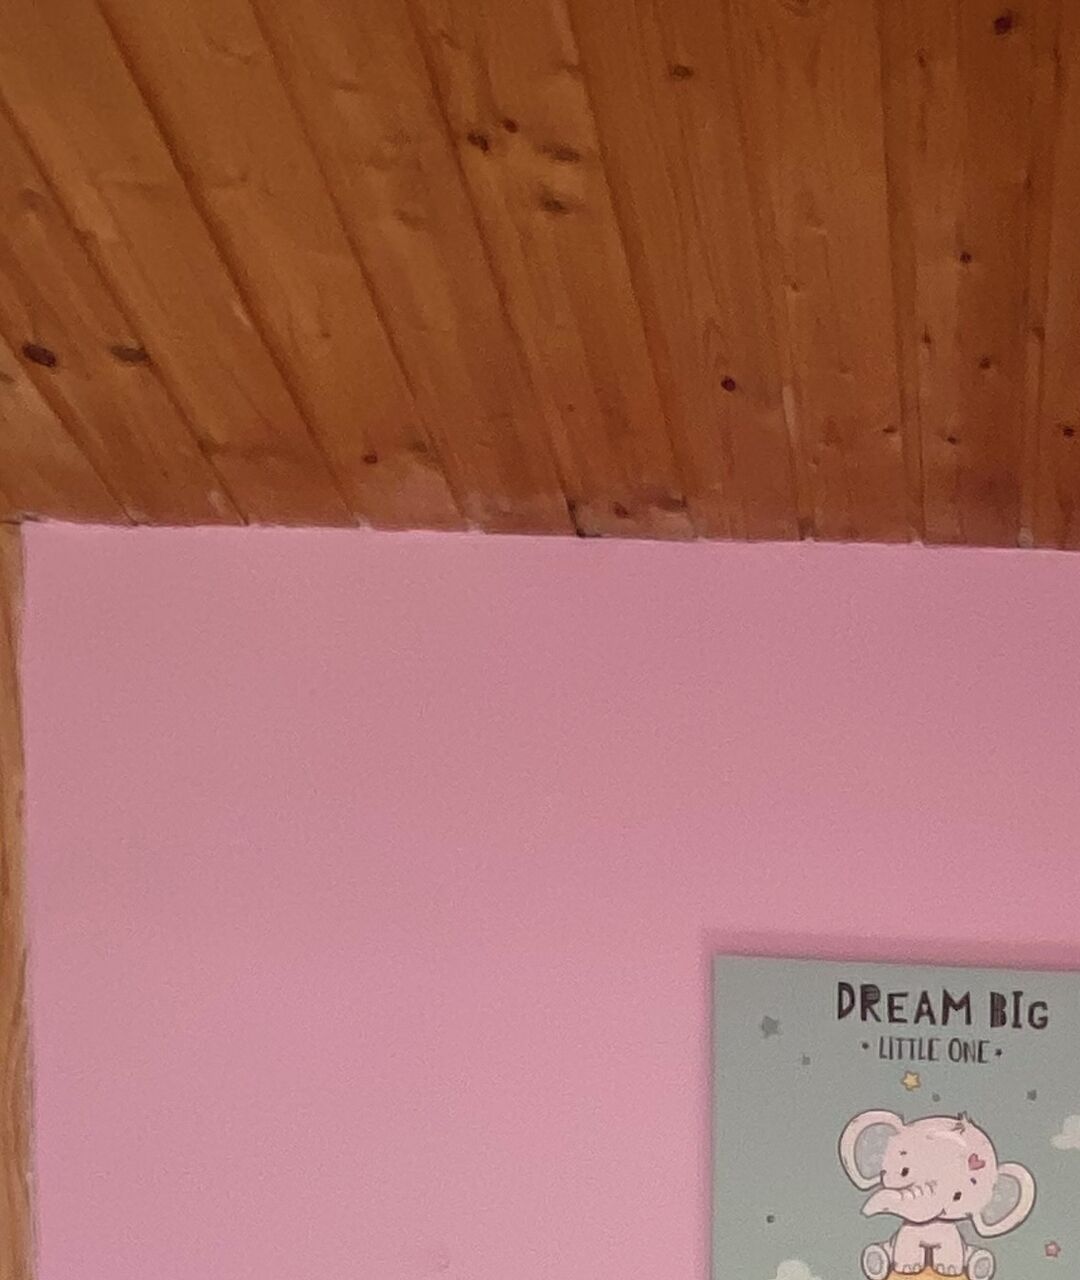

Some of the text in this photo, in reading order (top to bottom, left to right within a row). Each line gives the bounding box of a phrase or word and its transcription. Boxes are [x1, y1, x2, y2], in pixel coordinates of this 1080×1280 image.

[836, 980, 1049, 1031] DREAM BIG
[878, 1036, 991, 1064] LITTLE ONE
